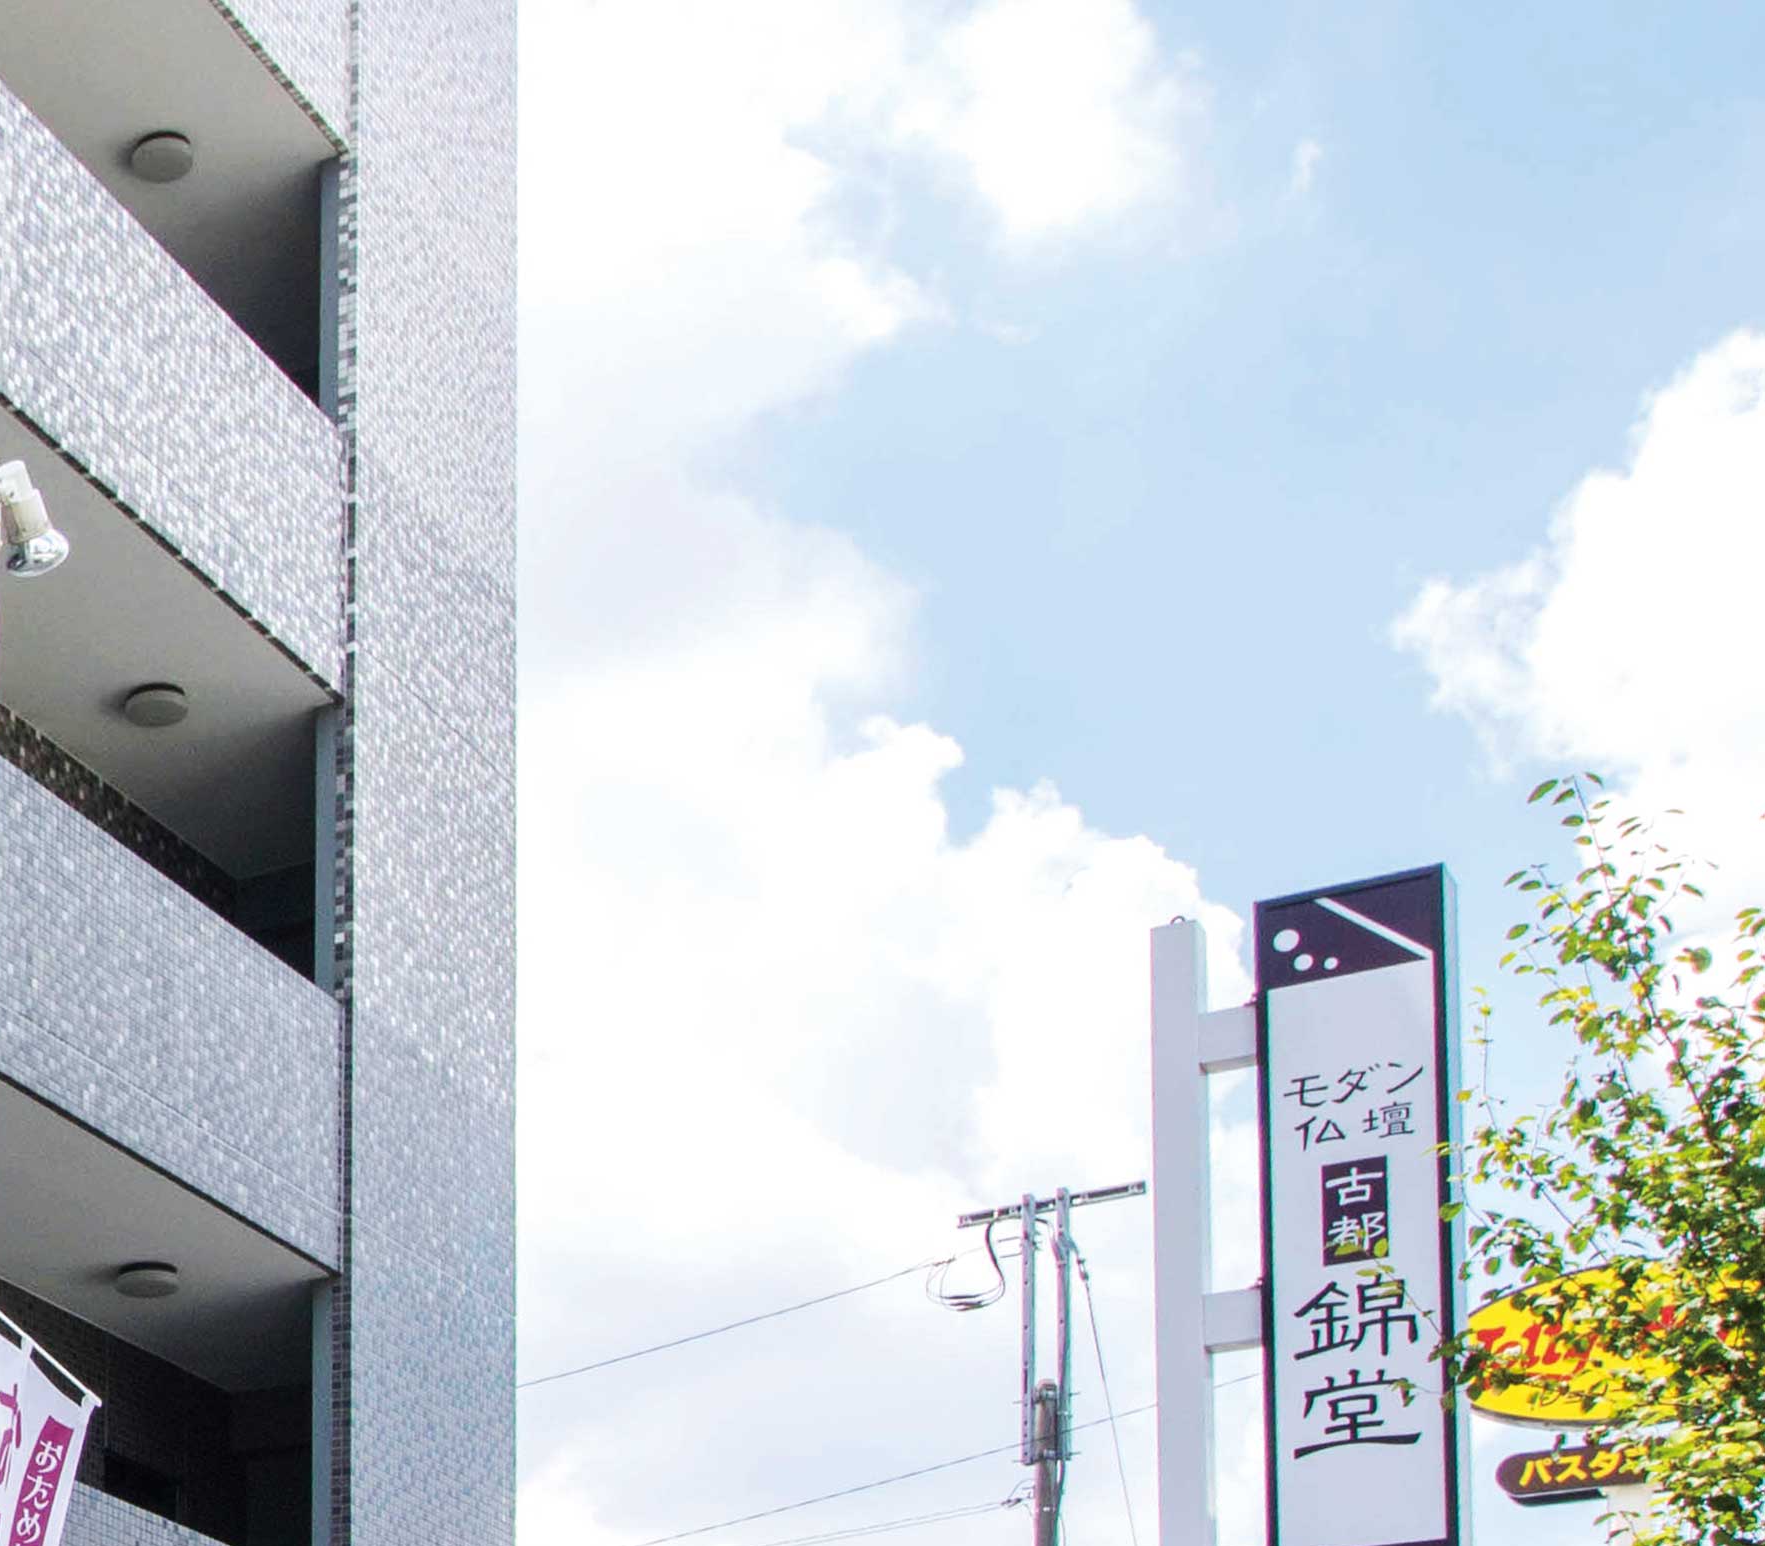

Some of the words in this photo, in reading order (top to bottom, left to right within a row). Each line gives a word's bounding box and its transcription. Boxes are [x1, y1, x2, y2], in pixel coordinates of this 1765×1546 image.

[1282, 1062, 1424, 1108] モダン
[1294, 1101, 1415, 1152] 仏壇
[1324, 1166, 1387, 1252] 古都
[1293, 1272, 1422, 1460] 錦堂
